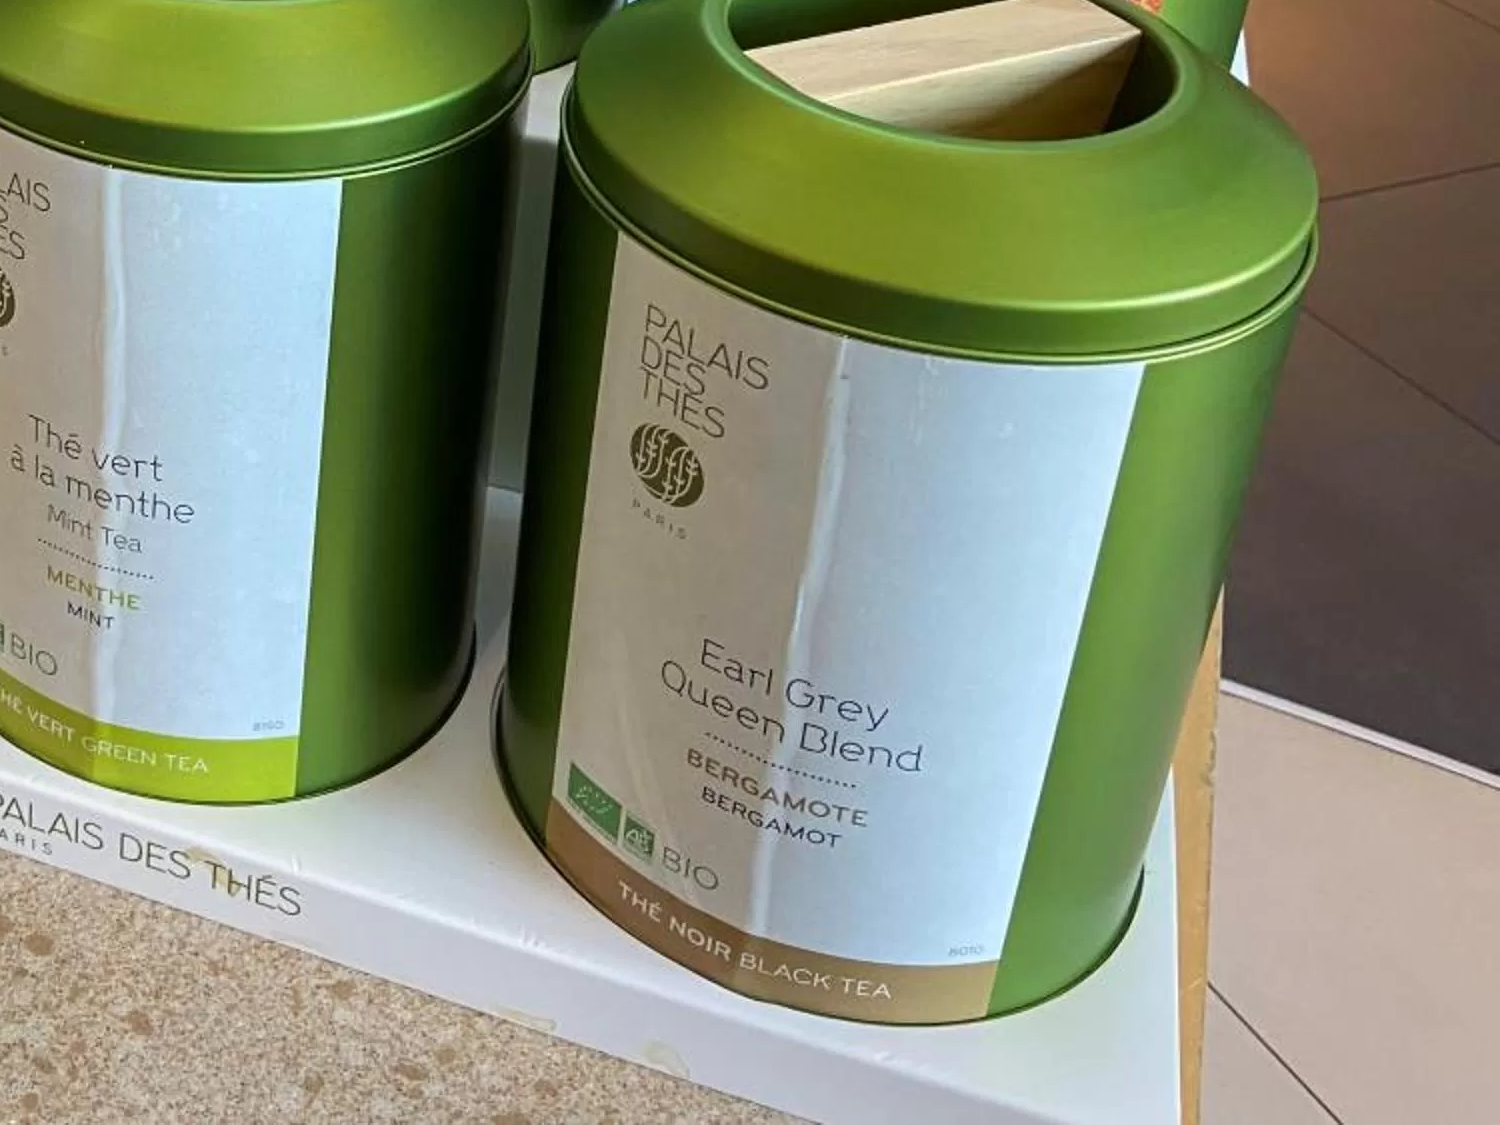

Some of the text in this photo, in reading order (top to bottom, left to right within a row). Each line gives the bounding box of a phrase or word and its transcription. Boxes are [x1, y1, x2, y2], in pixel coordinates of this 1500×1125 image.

[640, 334, 707, 396] DES
[645, 303, 769, 390] PALAIS
[29, 413, 163, 482] Thé vert
[10, 444, 195, 523] à la menthe
[47, 504, 142, 554] Mint Tea
[47, 566, 141, 610] MENTHE
[67, 601, 115, 629] MINT
[10, 632, 58, 676] BIO
[700, 638, 889, 732] Earl Grey
[27, 708, 75, 743] VERT
[82, 736, 156, 767] GREEN
[164, 752, 209, 774] TEA
[661, 660, 923, 772] Queen Blend
[687, 748, 869, 827] BERGAMOTE
[701, 786, 843, 848] BERGAMOT
[119, 832, 192, 880] DES
[204, 858, 302, 917] THÉS
[662, 846, 719, 890] BIO
[669, 915, 733, 963] NOIR
[739, 952, 833, 990] BLACK
[842, 977, 893, 1000] TEA
